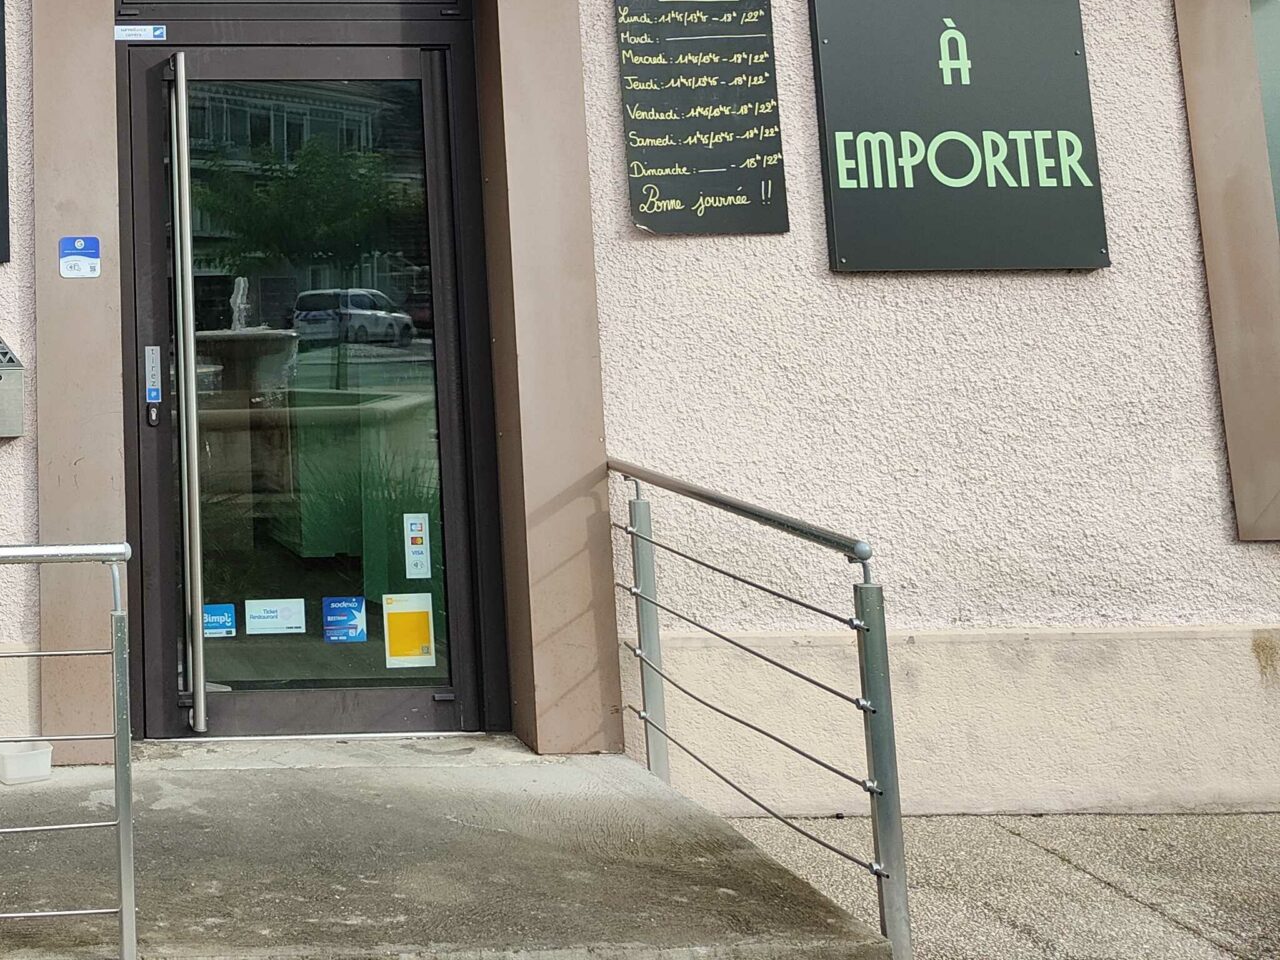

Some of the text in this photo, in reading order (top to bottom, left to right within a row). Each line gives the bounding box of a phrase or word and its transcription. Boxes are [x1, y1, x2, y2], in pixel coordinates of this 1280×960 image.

[938, 18, 972, 85] À
[835, 130, 1093, 189] EMPORTER
[639, 184, 686, 213] Bonne
[691, 186, 751, 217] journée
